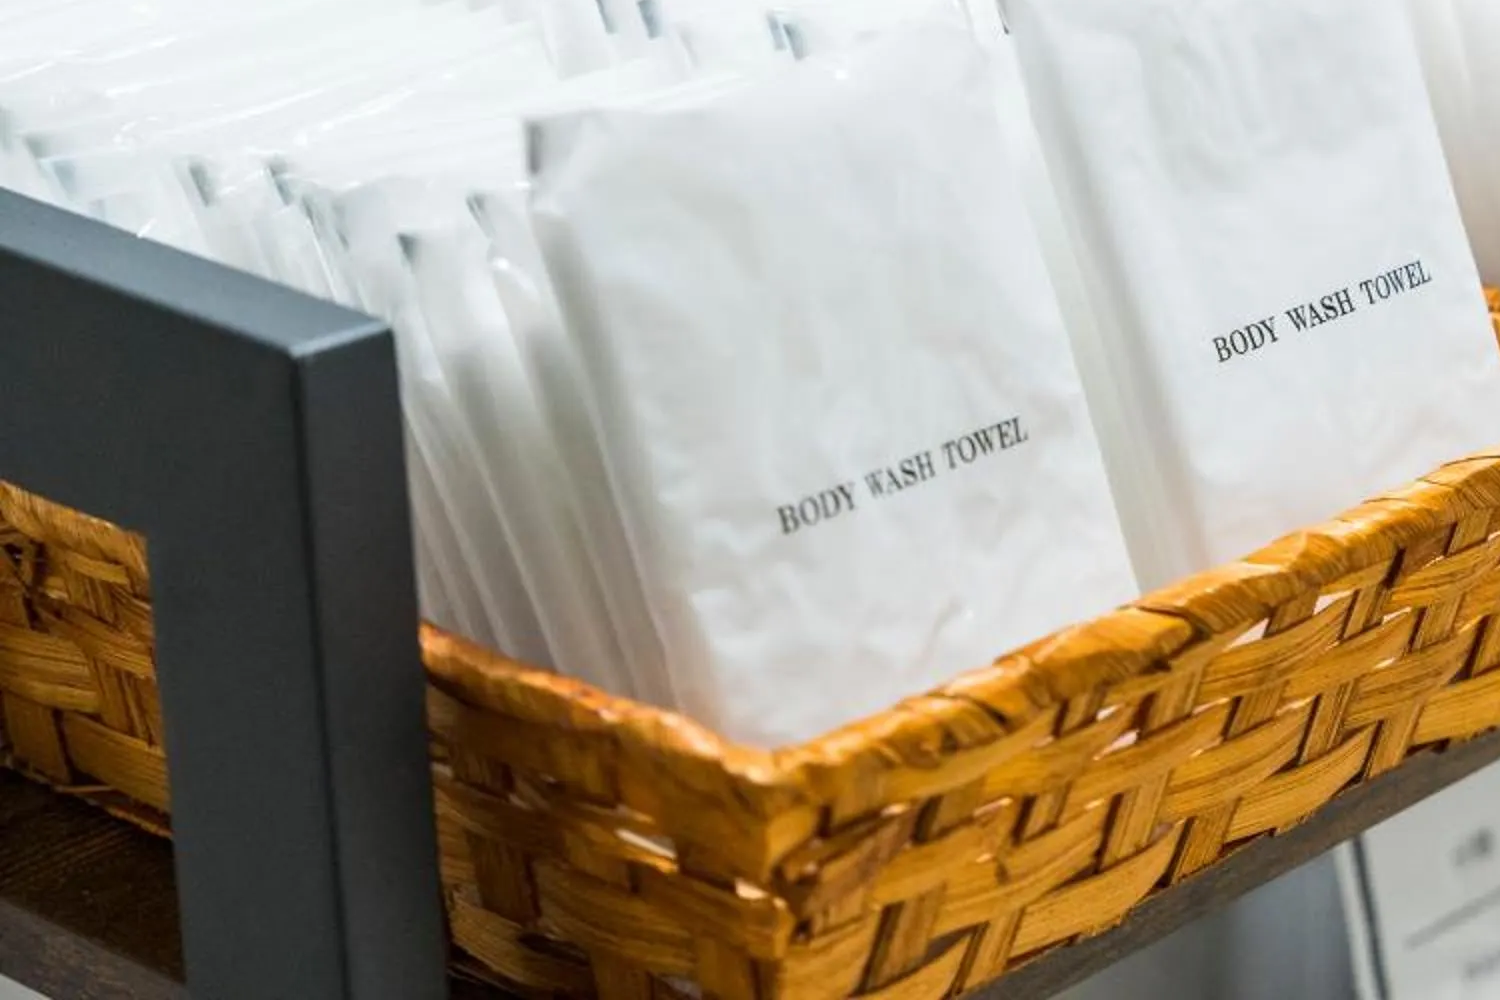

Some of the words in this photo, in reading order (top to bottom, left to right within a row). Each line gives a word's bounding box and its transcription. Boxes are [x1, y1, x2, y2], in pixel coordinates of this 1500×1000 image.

[1212, 315, 1278, 363] BODY
[1285, 288, 1356, 333] WASH
[1359, 260, 1433, 305] TOWEL
[776, 481, 856, 535] BODY
[864, 451, 936, 499] WASH
[941, 416, 1030, 470] TOWEL
